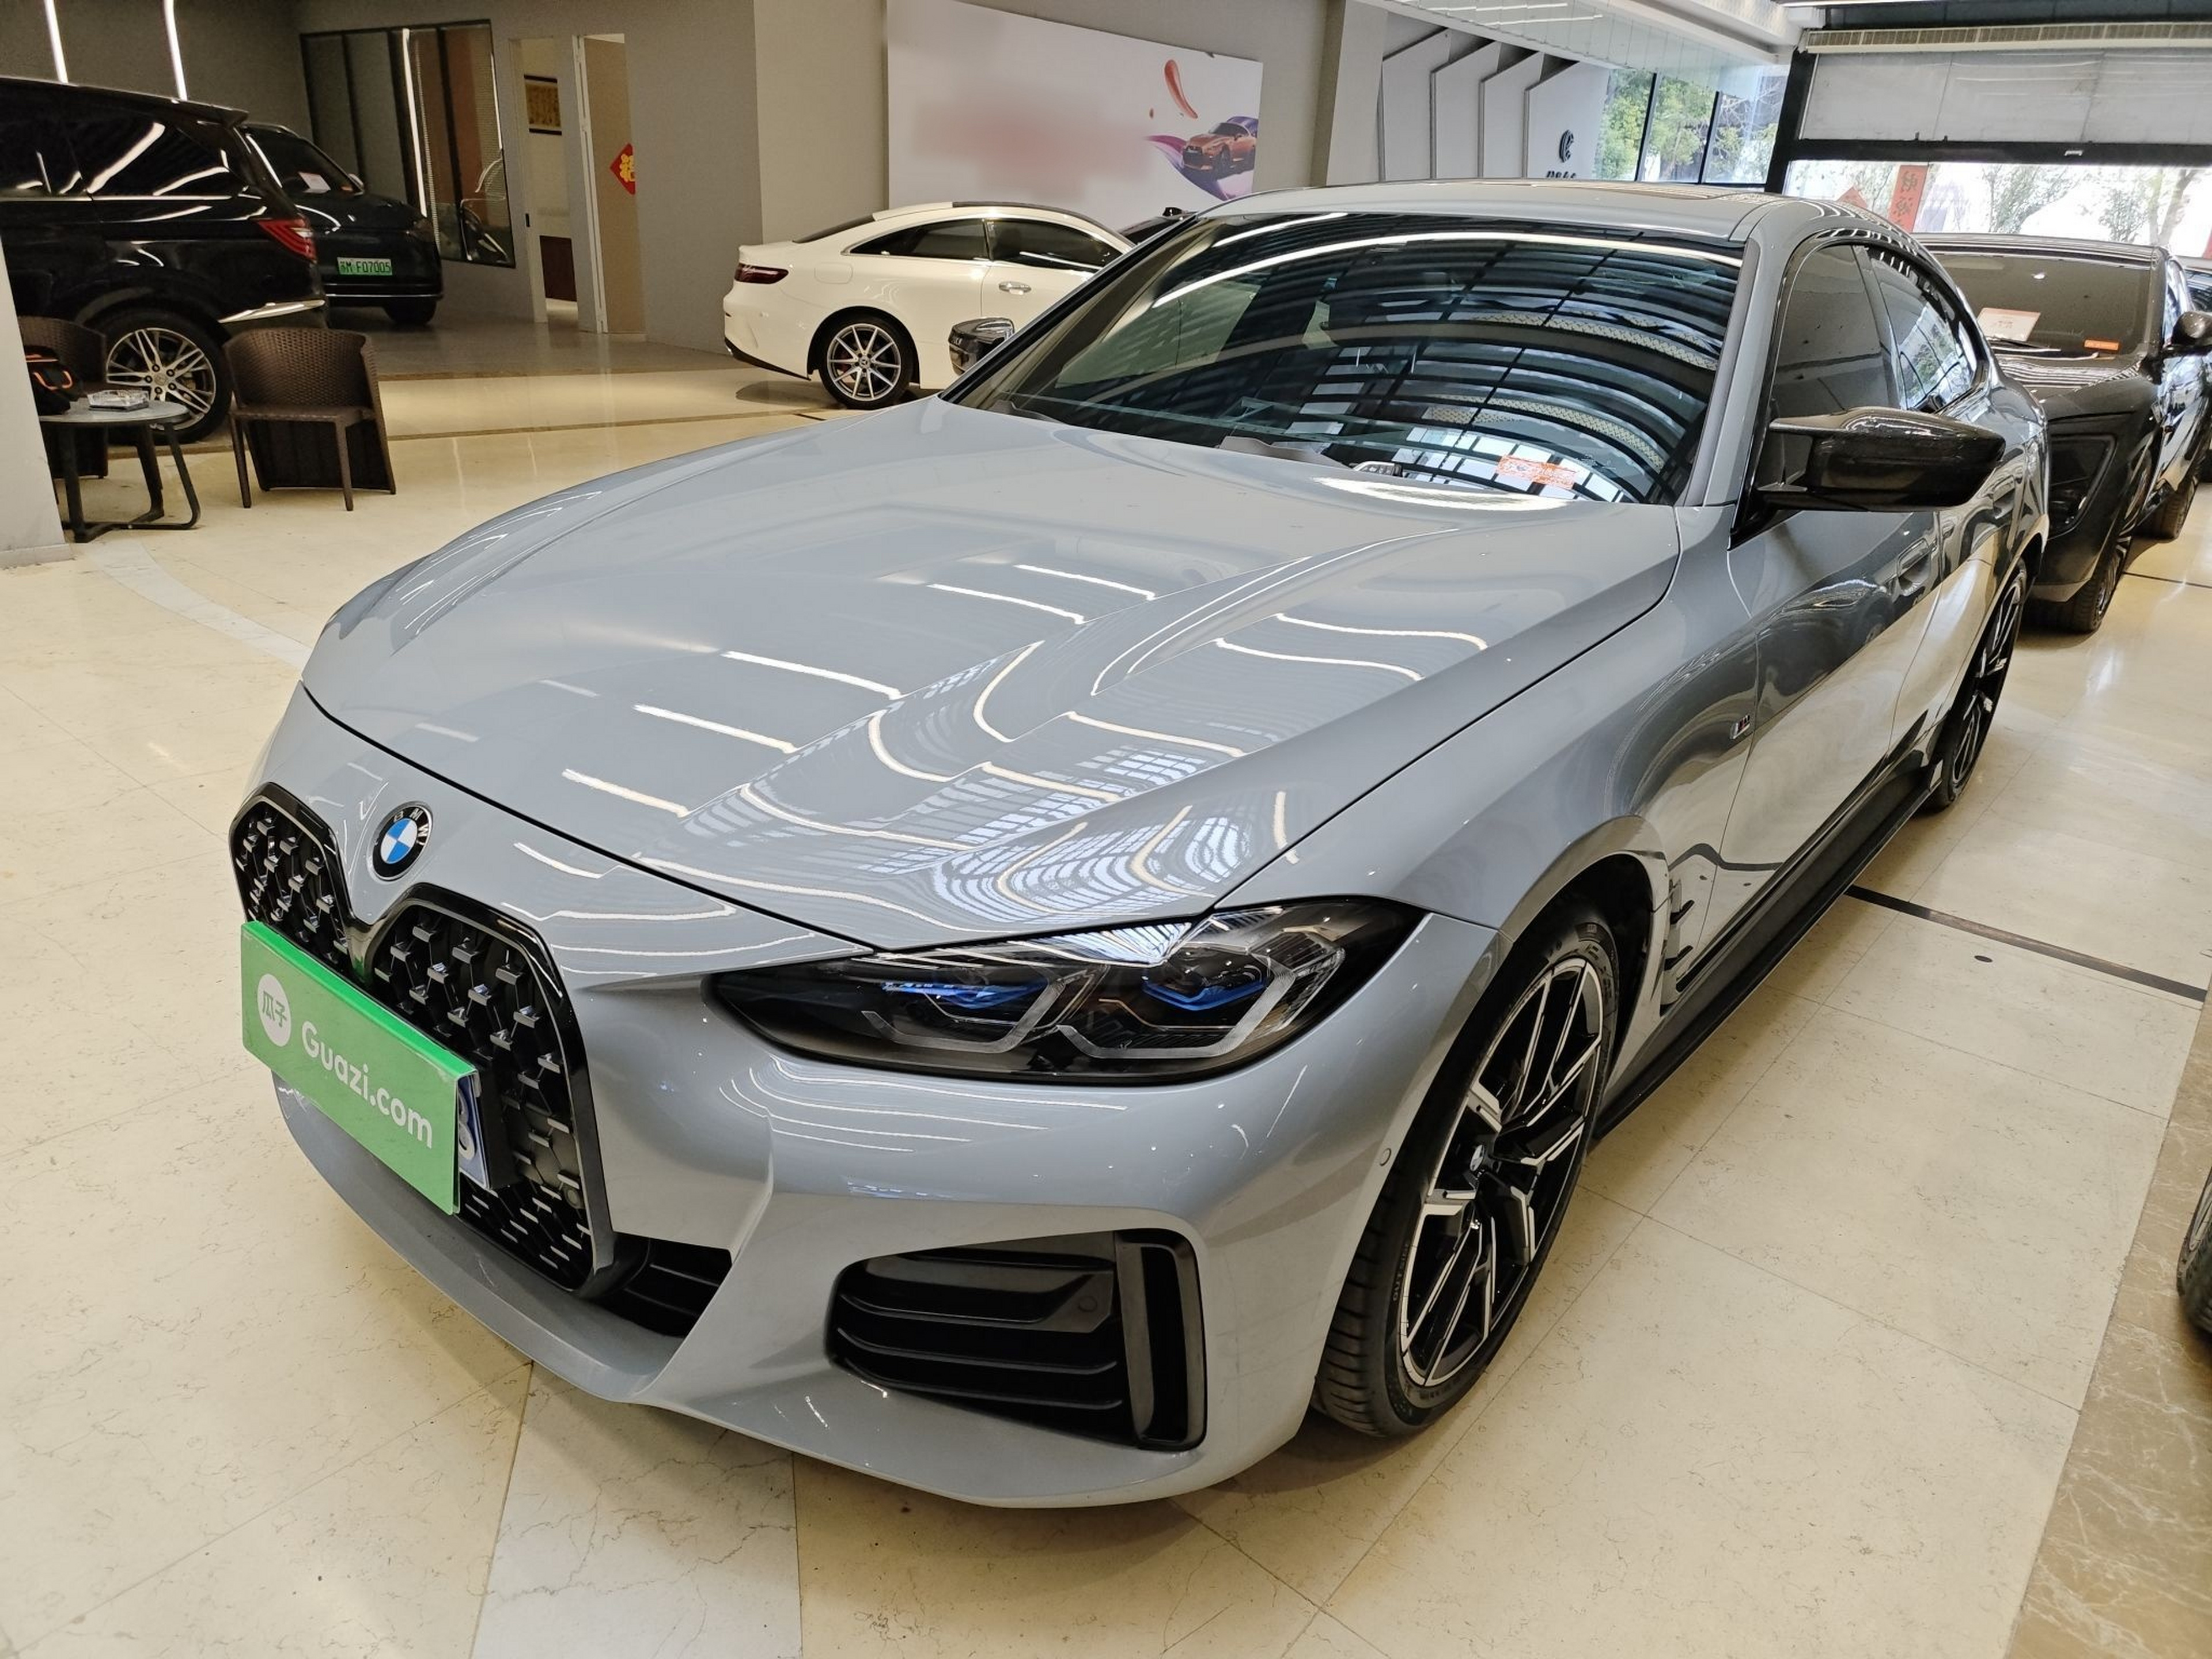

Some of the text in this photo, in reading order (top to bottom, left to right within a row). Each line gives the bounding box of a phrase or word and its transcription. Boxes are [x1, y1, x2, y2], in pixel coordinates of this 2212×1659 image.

[393, 808, 429, 846] BMW
[263, 990, 287, 1028] 瓜子
[301, 1021, 433, 1149] Guazi.com
